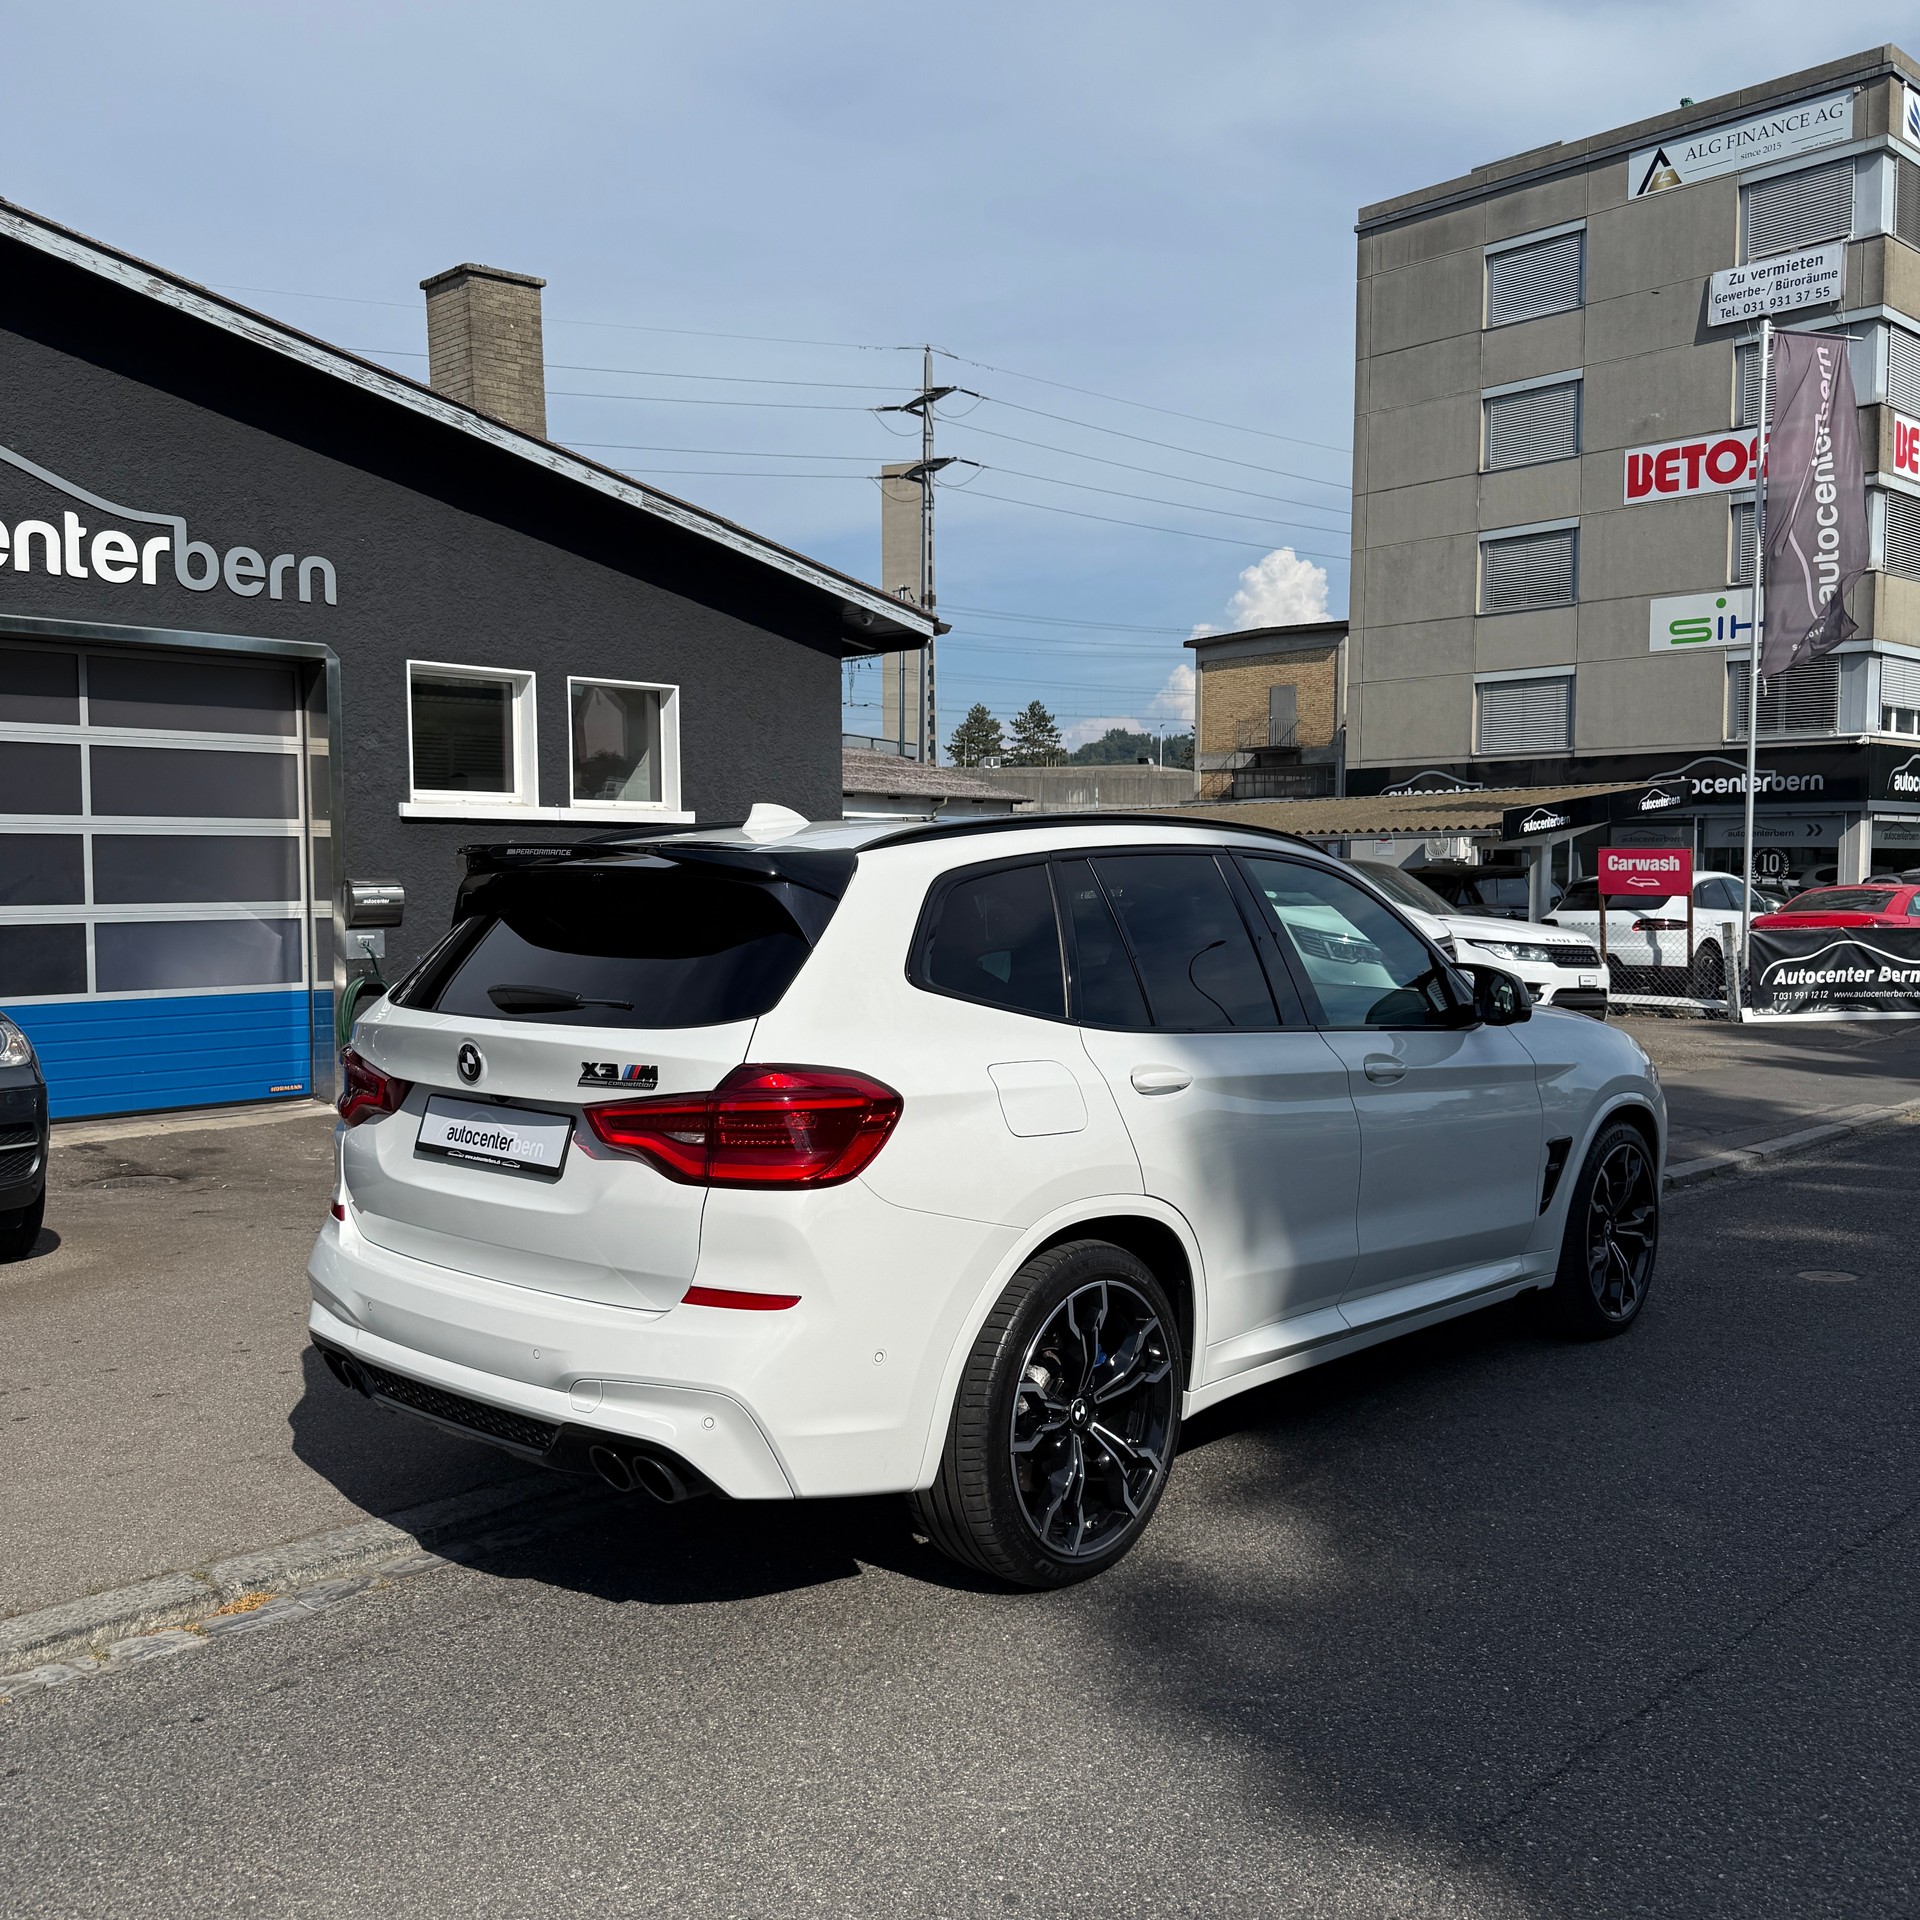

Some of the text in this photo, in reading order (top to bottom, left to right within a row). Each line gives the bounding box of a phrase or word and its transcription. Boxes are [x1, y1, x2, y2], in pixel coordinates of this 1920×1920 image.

[1685, 102, 1844, 162] ALG FINANCE AG
[1740, 141, 1782, 161] since 2015
[1729, 255, 1824, 286] Zu vermieten
[1720, 286, 1830, 319] Tel. 031 931 37 55
[1895, 420, 1920, 475] BE
[0, 511, 337, 606] nterbern
[1894, 771, 1920, 792] autoc
[1607, 855, 1680, 871] Carwash
[1762, 854, 1780, 873] 10
[1772, 965, 1920, 985] Autocenter Bern
[1773, 992, 1778, 1000] T
[1778, 992, 1792, 1000] 031
[1795, 991, 1808, 999] 991
[1811, 990, 1819, 999] 12
[1820, 990, 1829, 999] 12
[581, 1062, 619, 1079] X3
[606, 1080, 654, 1088] competition
[446, 1125, 544, 1158] autocenterbern
